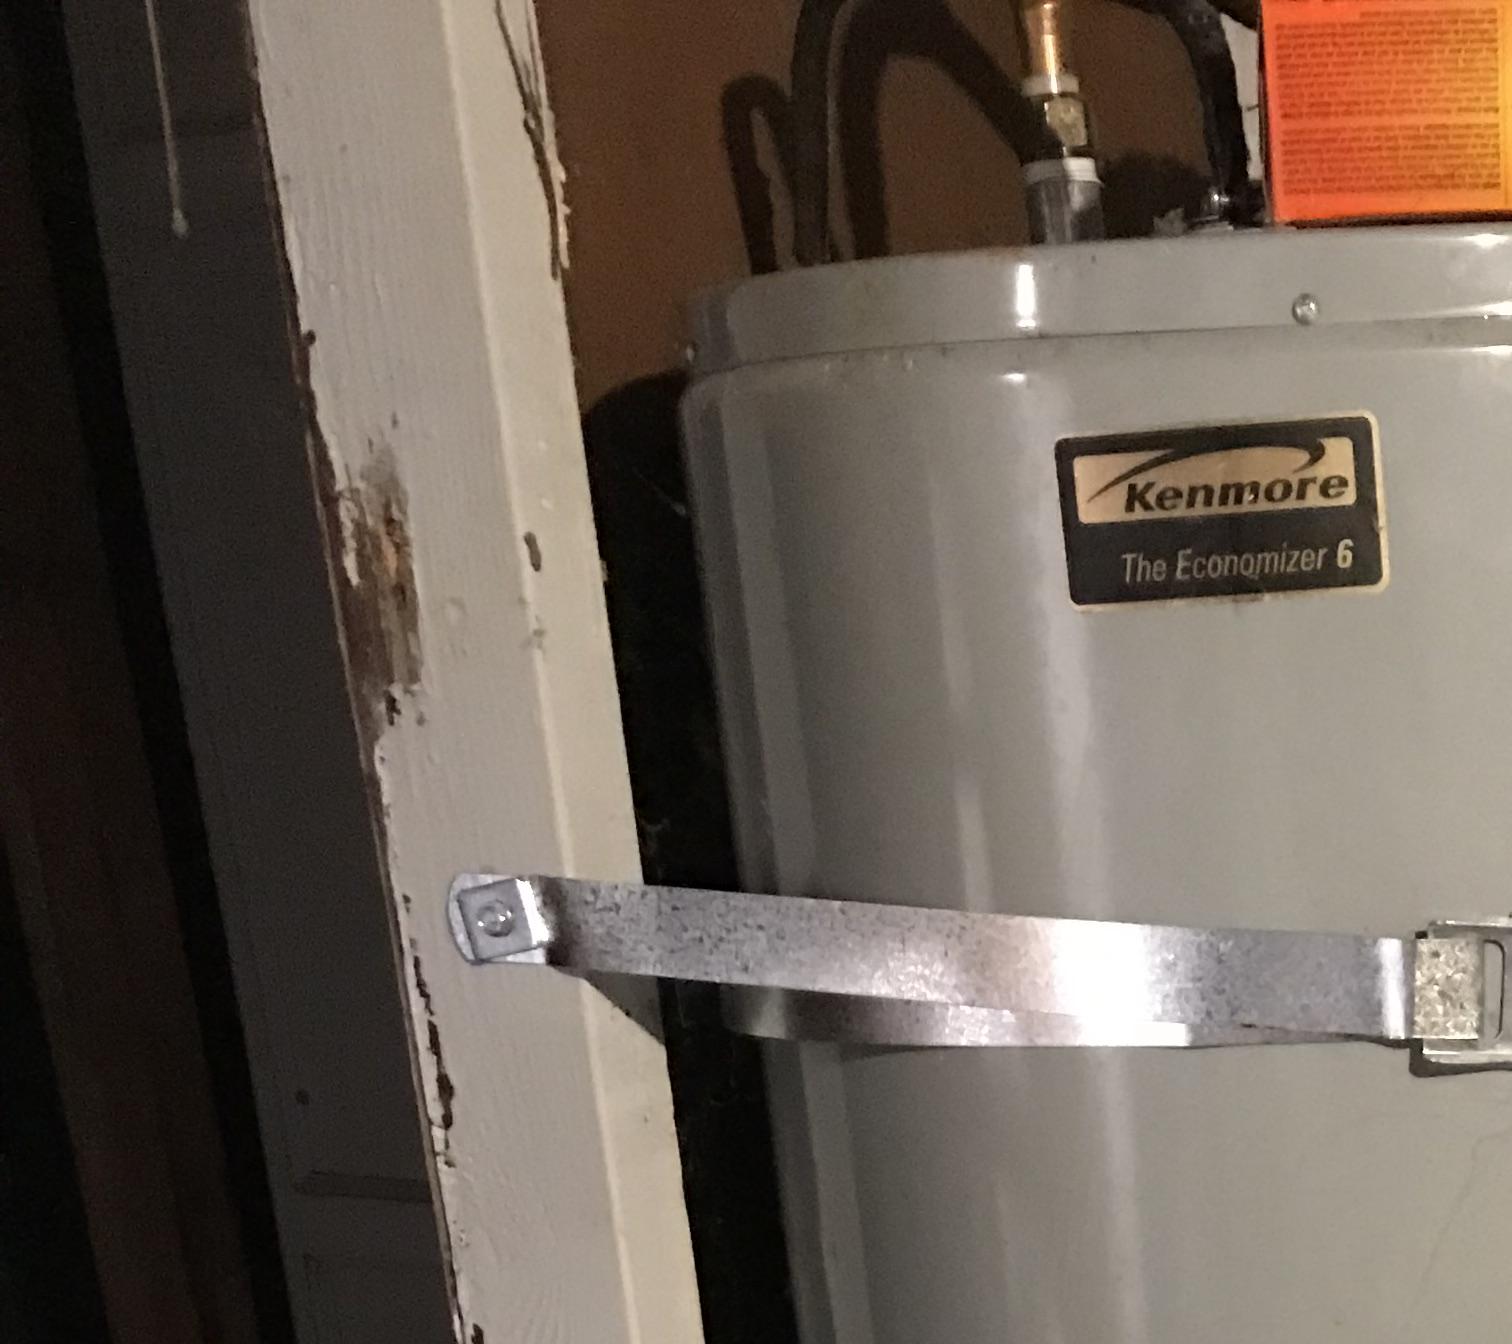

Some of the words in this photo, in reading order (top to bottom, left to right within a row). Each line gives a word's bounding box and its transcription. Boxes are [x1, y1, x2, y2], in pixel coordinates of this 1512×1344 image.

[1125, 474, 1349, 513] Kenmore
[1122, 553, 1167, 584] The
[1175, 546, 1329, 582] Economizer
[1336, 539, 1354, 568] 6
